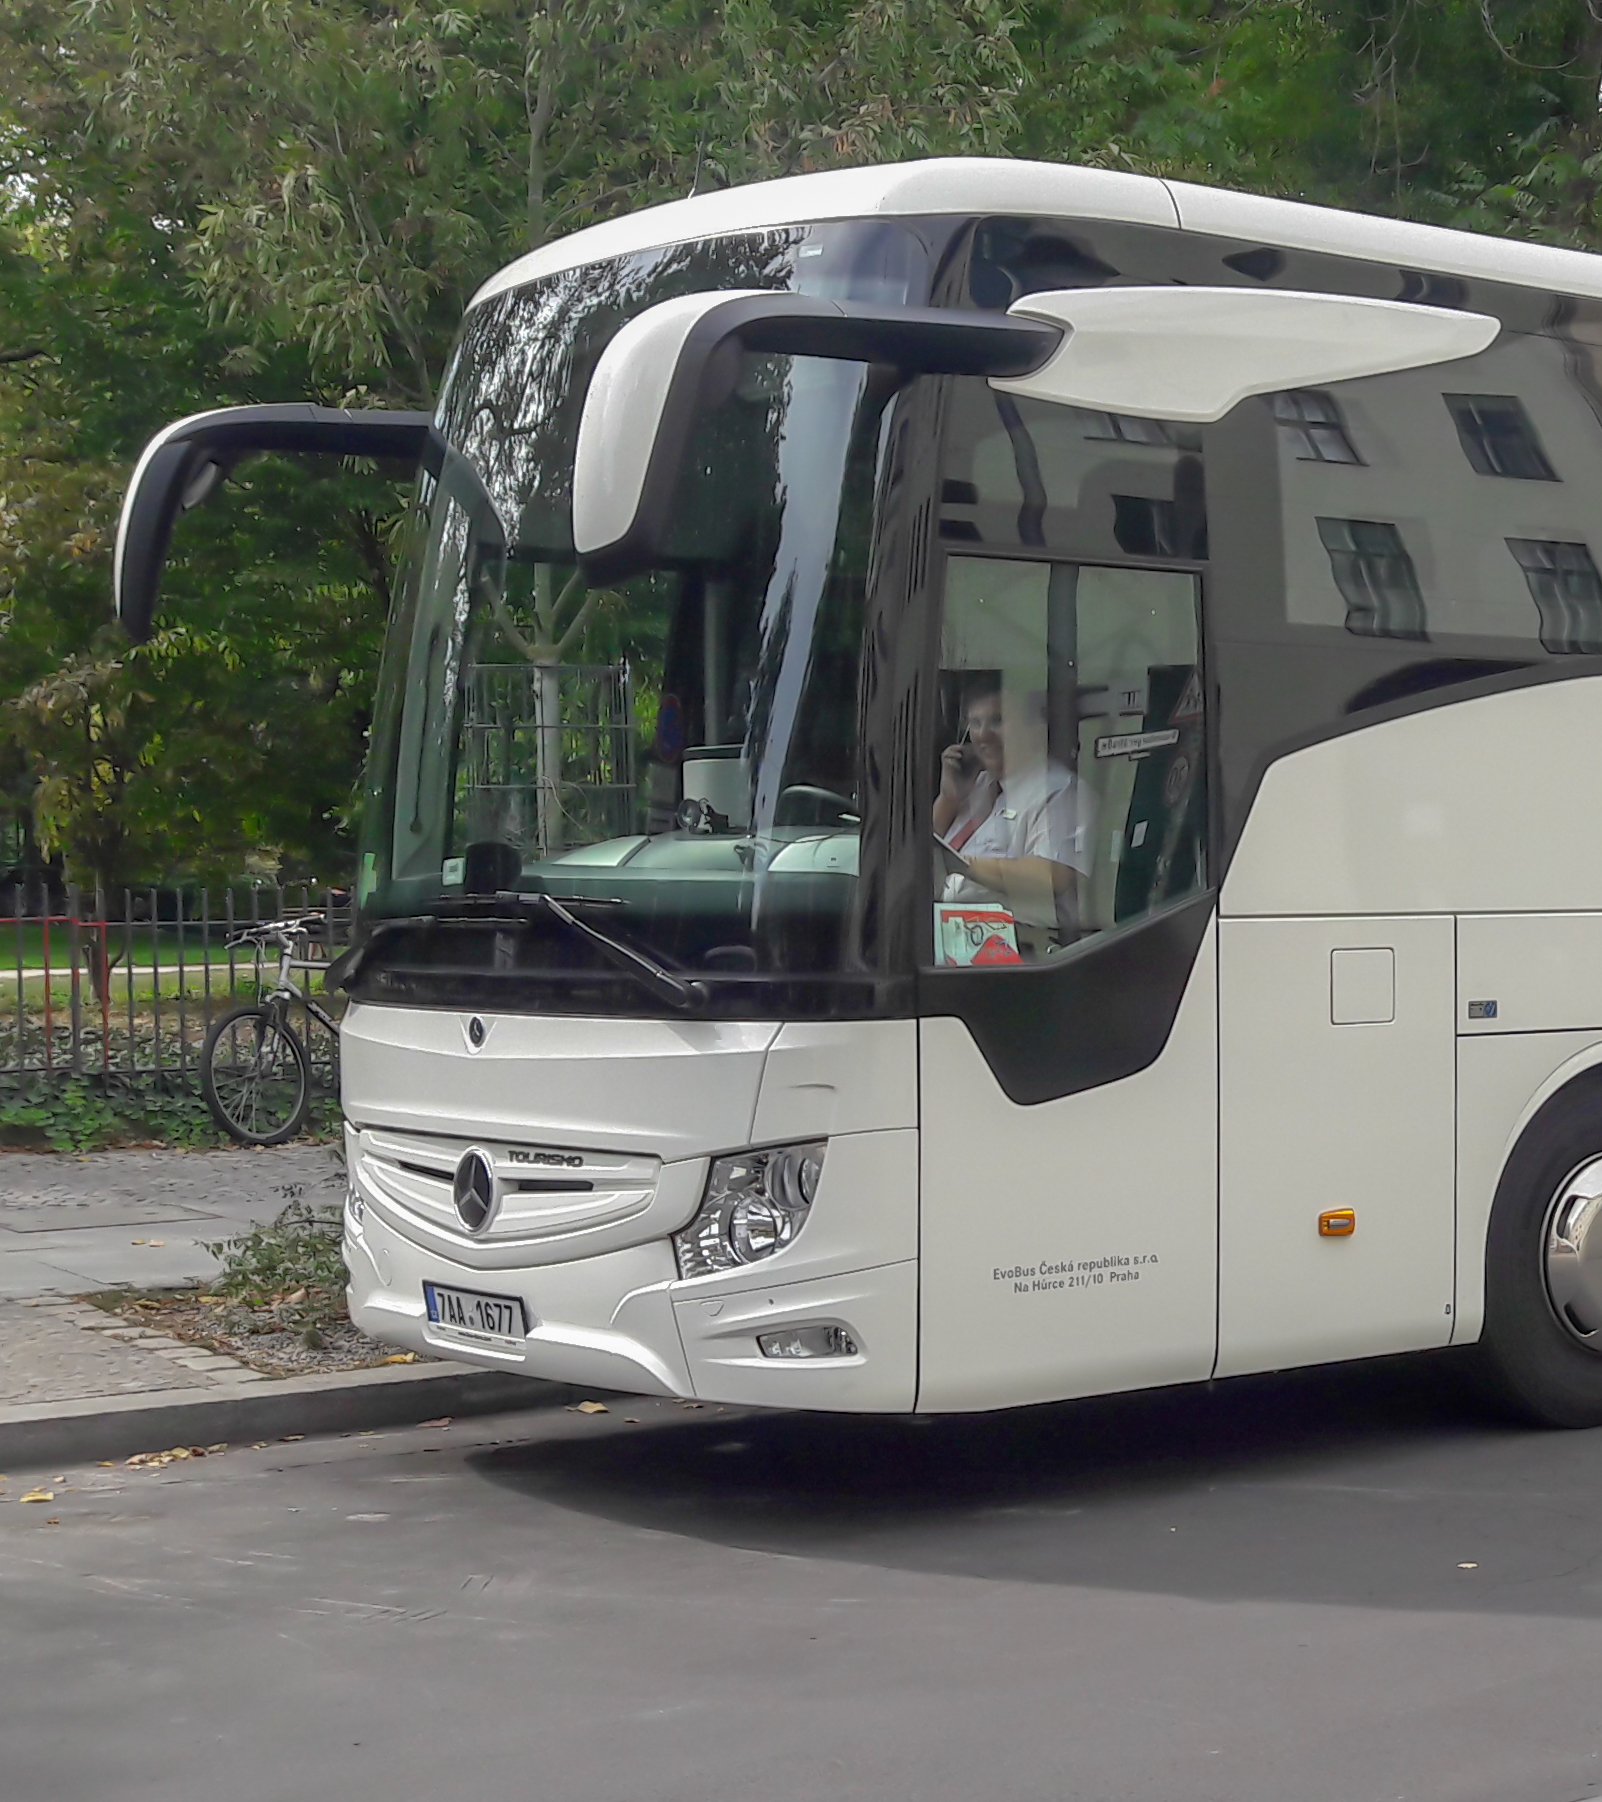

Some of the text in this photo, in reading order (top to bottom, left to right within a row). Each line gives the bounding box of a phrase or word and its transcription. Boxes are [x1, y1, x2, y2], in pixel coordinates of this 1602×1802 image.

[508, 1150, 584, 1168] TOURISMO
[993, 1266, 1036, 1281] EvoBus
[1039, 1260, 1074, 1276] Česká
[1077, 1255, 1130, 1273] republika
[1013, 1281, 1029, 1293] Na
[1068, 1272, 1104, 1289] 211/10
[1110, 1269, 1140, 1283] Praha
[436, 1292, 512, 1334] 7AA 1677
